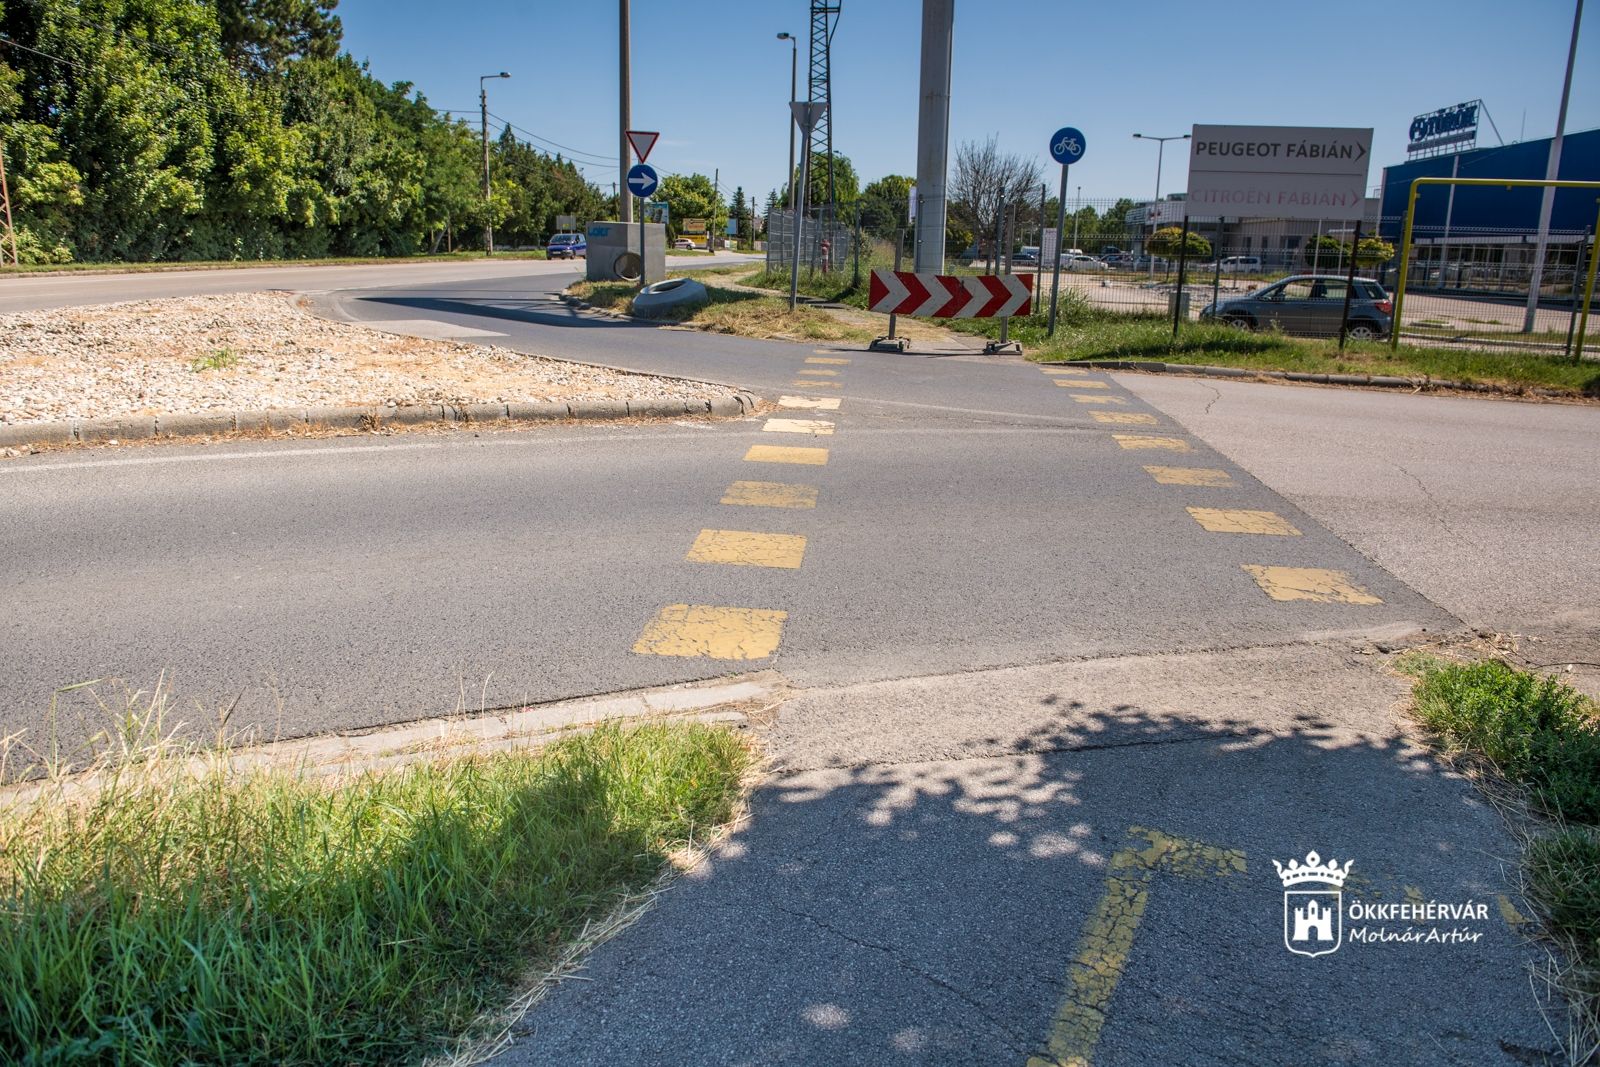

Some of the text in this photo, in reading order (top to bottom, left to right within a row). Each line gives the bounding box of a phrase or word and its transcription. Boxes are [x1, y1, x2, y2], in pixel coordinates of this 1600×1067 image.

[1196, 139, 1353, 159] PEUGEOT FÁBIÁN
[1191, 186, 1270, 204] CITROËN
